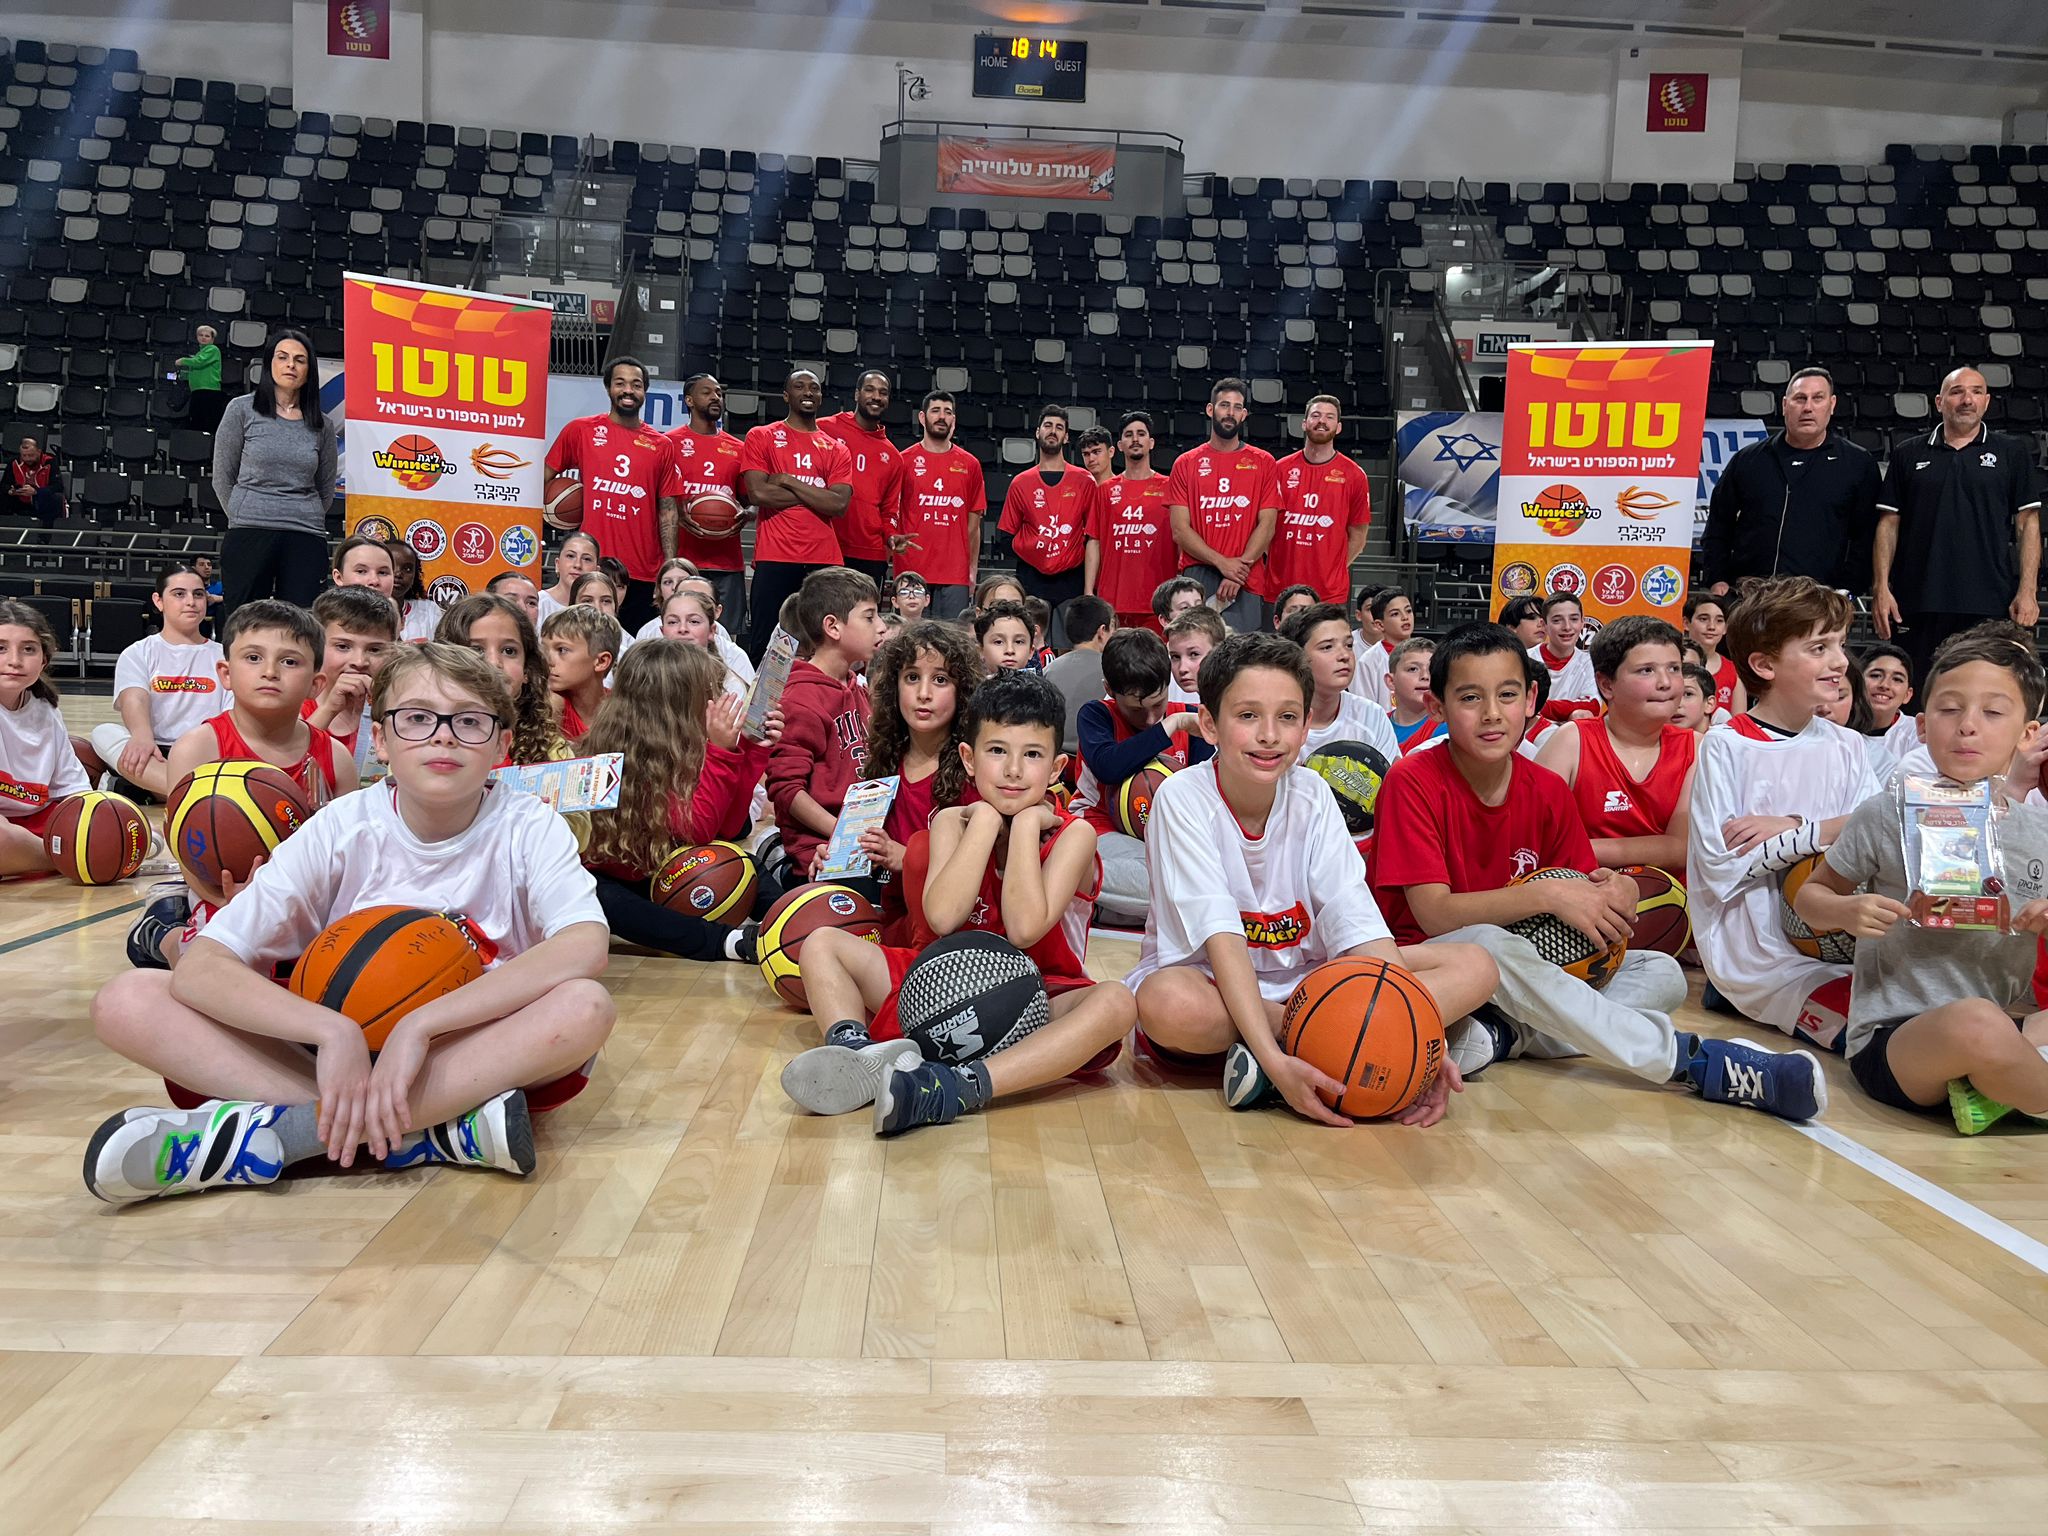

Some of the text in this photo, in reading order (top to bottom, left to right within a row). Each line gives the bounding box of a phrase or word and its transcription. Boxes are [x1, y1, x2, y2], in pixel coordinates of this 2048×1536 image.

[346, 42, 371, 52] טוטו
[980, 56, 1008, 68] HOME
[1054, 60, 1082, 72] GUEST
[1664, 118, 1688, 126] טוטו
[961, 158, 1090, 179] עמדת טלוויזיה
[372, 341, 528, 407] טוטו
[376, 397, 526, 429] למען הספורט בישראל
[1528, 402, 1681, 449] טוטו
[374, 452, 456, 474] Winner סל
[416, 452, 440, 464] ליגת
[793, 452, 812, 469] 14
[856, 454, 866, 472] 0
[1528, 452, 1676, 471] למען הספורט בישראל
[614, 454, 630, 478] 3
[704, 461, 715, 477] 2
[474, 483, 520, 494] מנהלת
[592, 476, 632, 495] שובל
[934, 478, 944, 491] 4
[1218, 477, 1230, 492] 8
[476, 491, 518, 502] הליגה
[918, 494, 952, 506] שובל
[1200, 495, 1234, 509] שובל
[1302, 493, 1318, 508] 10
[1122, 506, 1144, 520] 44
[1523, 502, 1600, 518] Winner סל
[1561, 500, 1584, 511] ליגת
[1284, 510, 1318, 526] שובל
[1112, 523, 1143, 536] שובל
[1618, 524, 1666, 534] מנהלת
[1620, 532, 1662, 542] הליגה
[664, 860, 698, 886] Winner
[928, 1006, 976, 1038] STARTER
